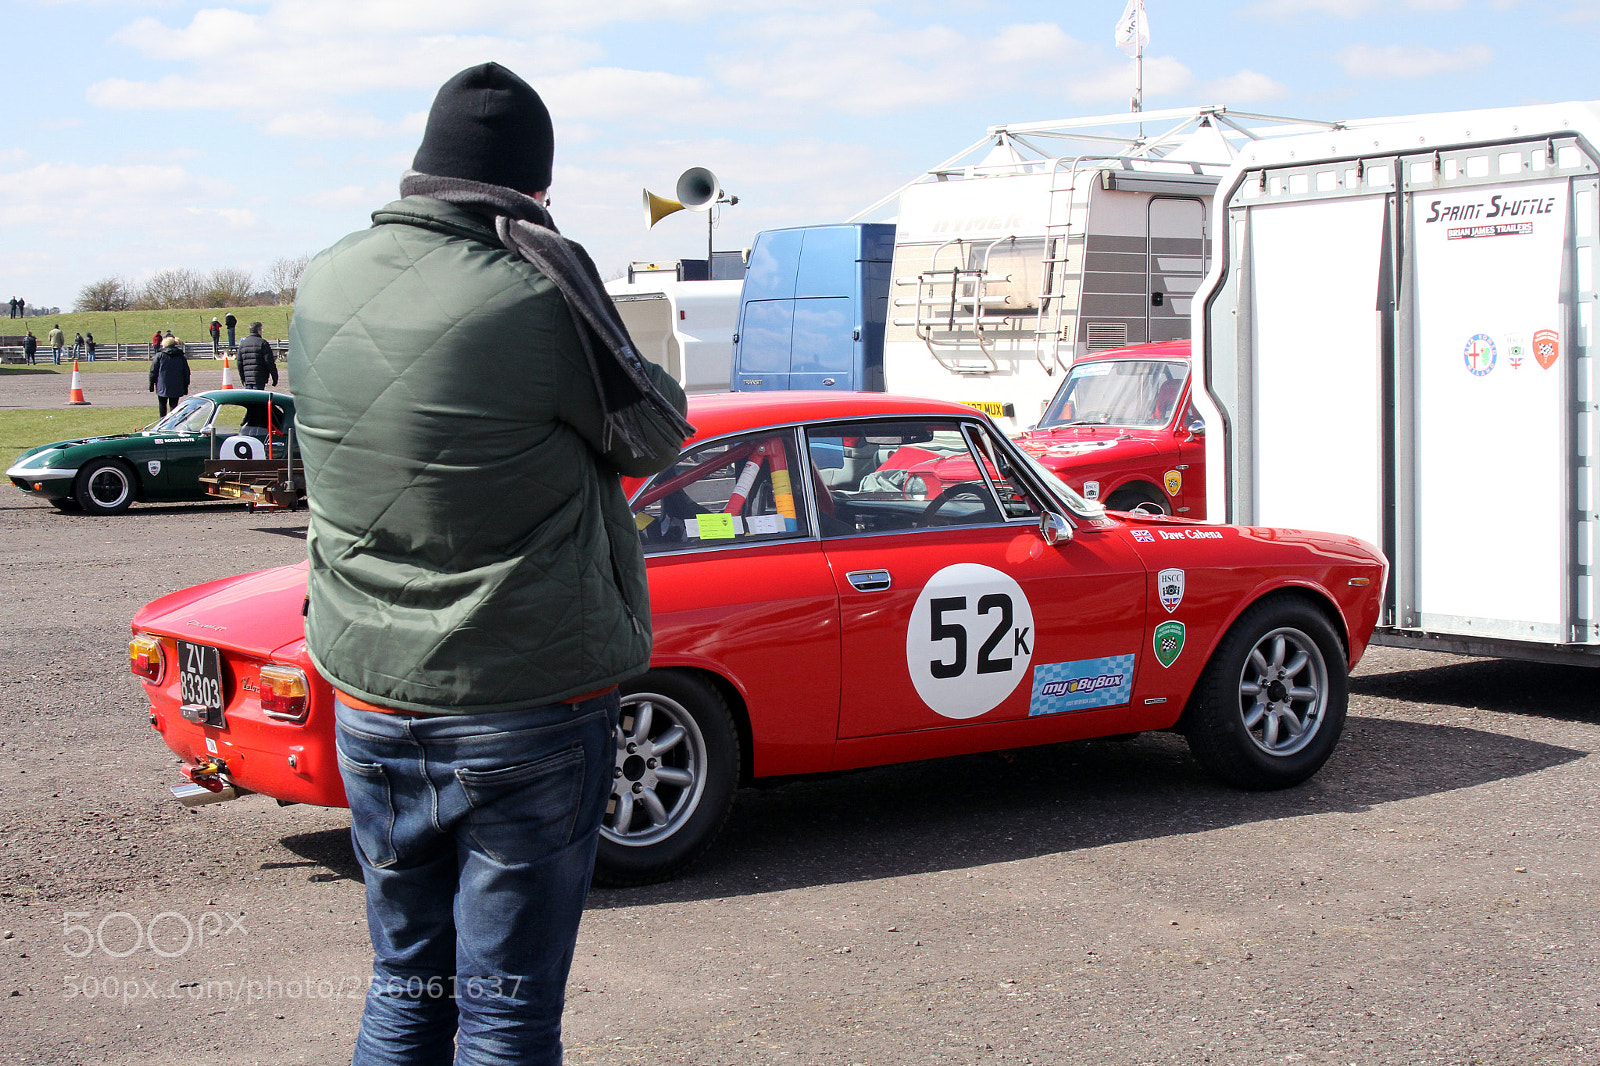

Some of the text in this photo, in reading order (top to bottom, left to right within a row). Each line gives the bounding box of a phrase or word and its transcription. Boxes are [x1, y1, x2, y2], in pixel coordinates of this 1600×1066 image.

[1448, 223, 1532, 237] BRIAN JAMES TRAILERS
[984, 403, 1002, 416] MUX
[233, 441, 253, 460] 9
[1158, 529, 1223, 540] Dave Cabena
[1162, 574, 1181, 582] HSCC
[186, 643, 205, 675] ZV
[180, 671, 220, 709] 83303
